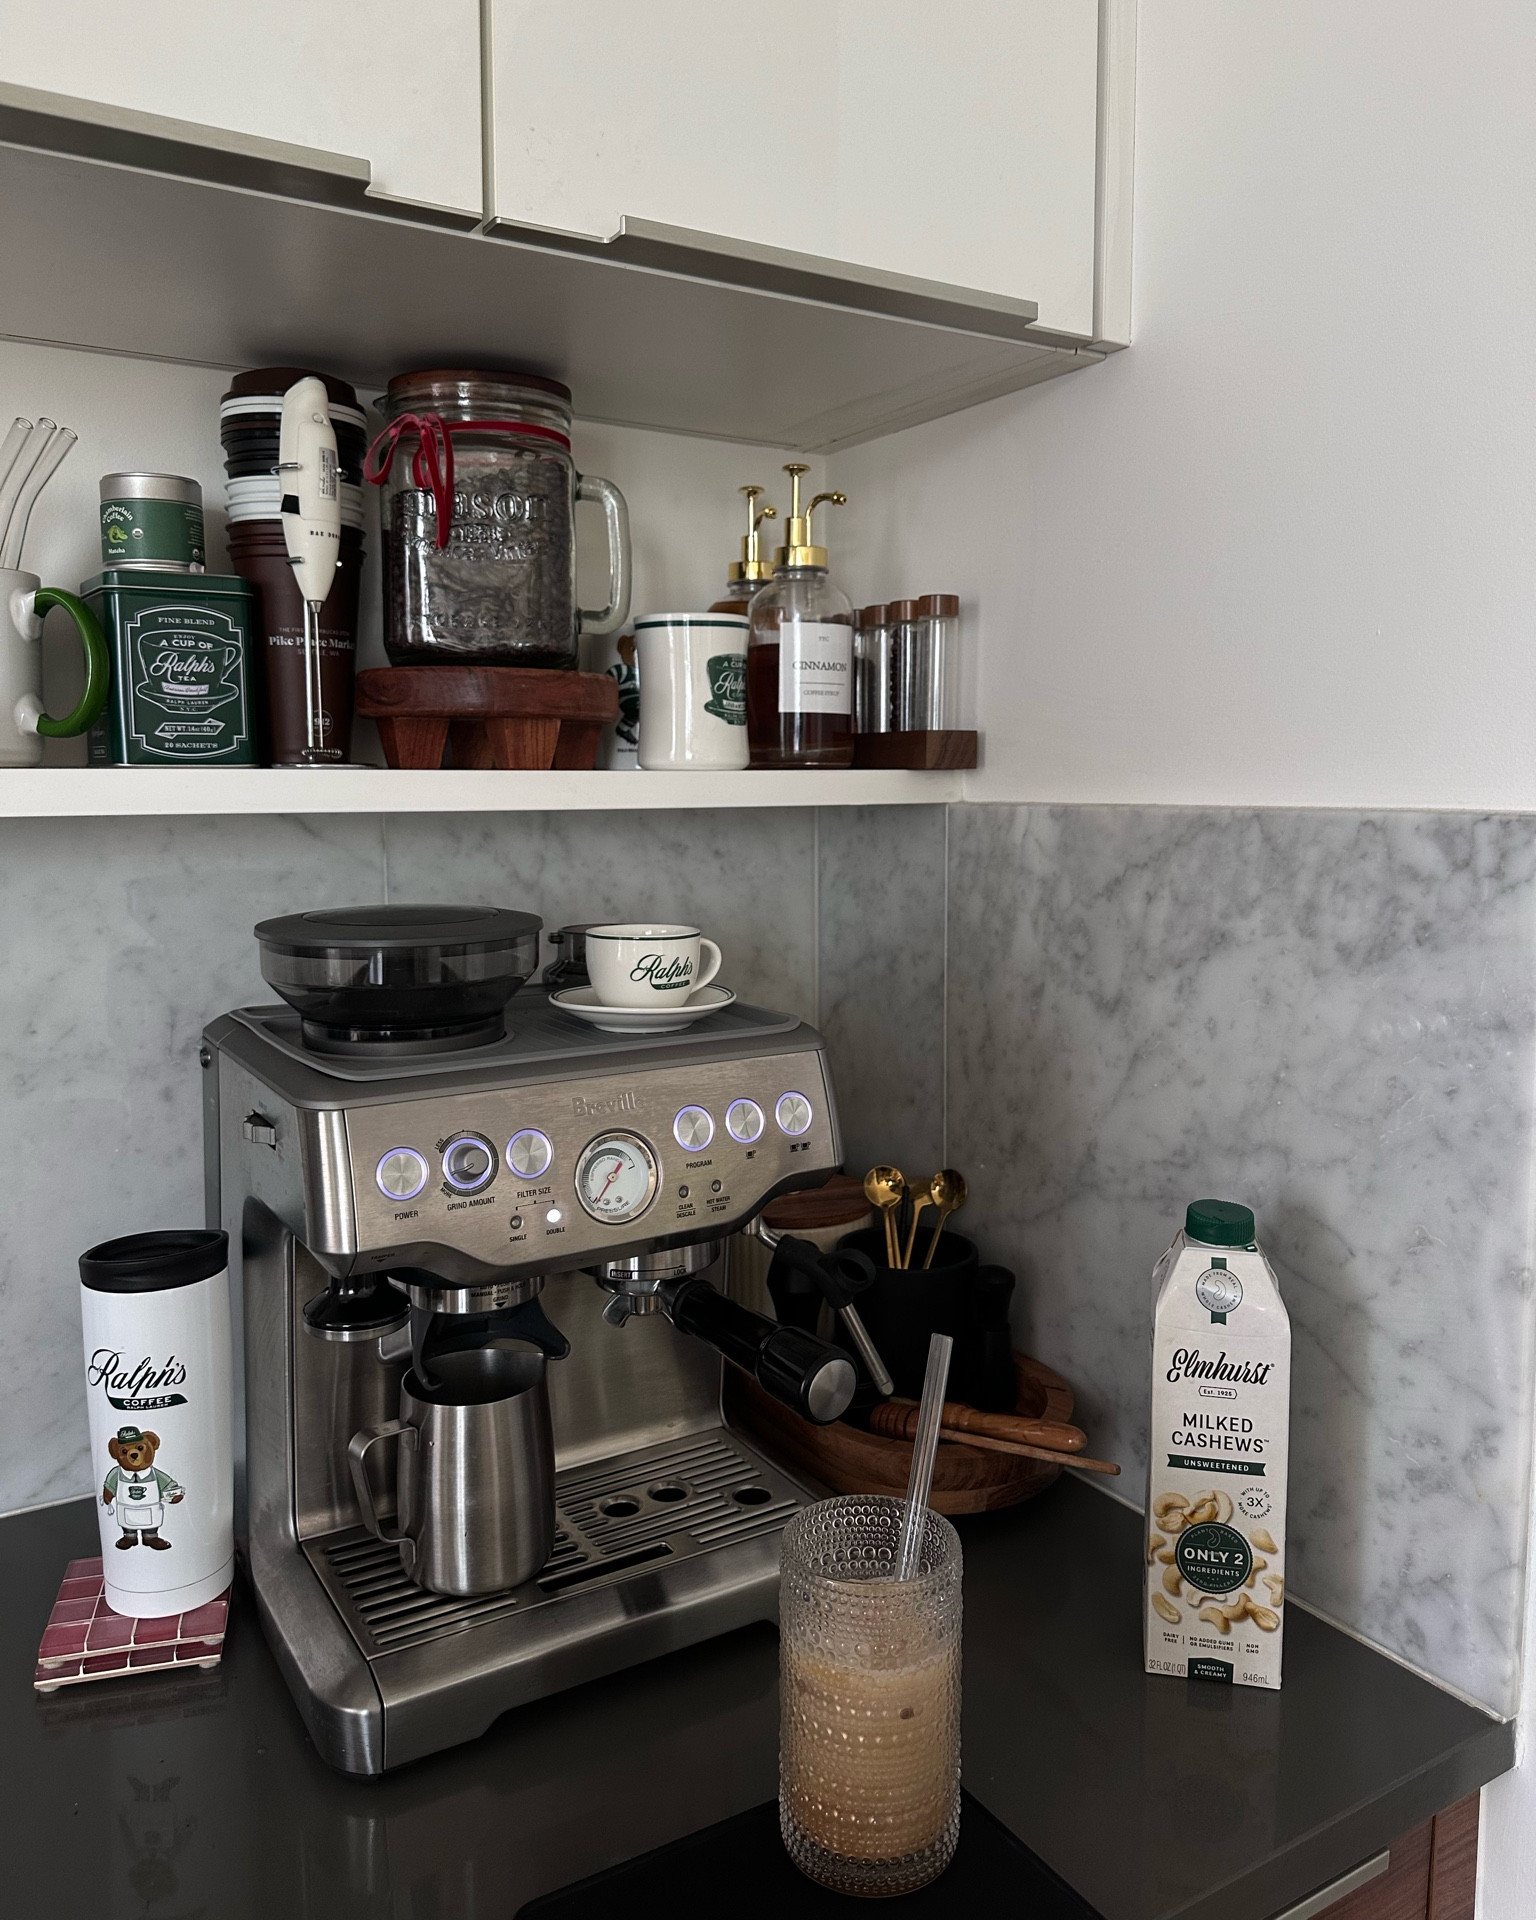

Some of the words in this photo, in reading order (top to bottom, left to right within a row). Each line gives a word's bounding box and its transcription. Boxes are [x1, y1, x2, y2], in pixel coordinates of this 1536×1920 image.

[107, 512, 124, 523] Coffee
[269, 635, 294, 646] Pike
[295, 637, 327, 648] Pace
[329, 638, 355, 650] Mark
[150, 651, 215, 683] Ralph's
[792, 660, 847, 672] CINNAMON
[630, 954, 693, 985] Ralph's
[660, 981, 686, 989] COFFEE
[434, 1137, 445, 1150] LESS
[685, 1159, 712, 1169] PROGRAM
[440, 1187, 454, 1198] MORE
[517, 1189, 537, 1199] FILTER
[538, 1186, 552, 1195] SIZE
[447, 1202, 467, 1211] GRIND
[468, 1197, 496, 1208] AMOUNT
[597, 1200, 630, 1213] PRESSURE
[678, 1202, 693, 1210] CLEAN
[394, 1210, 419, 1221] POWER
[676, 1210, 696, 1218] DESCALE
[546, 1227, 566, 1235] DOUBLE
[509, 1234, 527, 1242] SINGLE
[611, 1270, 632, 1278] INSERT
[673, 1268, 687, 1276] LOCK
[1201, 1273, 1212, 1286] MADE
[88, 1349, 187, 1397] Ralph's
[1217, 1389, 1233, 1397] 1925
[123, 1396, 172, 1406] COFFEE
[1183, 1413, 1253, 1433] MILKED
[1184, 1459, 1250, 1472] UNSWEETENED
[1240, 1487, 1254, 1496] WITH
[1246, 1496, 1263, 1508] 3X
[1238, 1502, 1249, 1516] MORE
[1184, 1547, 1229, 1563] ONLY
[1234, 1553, 1244, 1565] 2
[1187, 1565, 1240, 1577] INGREDIENTS
[1163, 1631, 1179, 1639] DAIRY
[1198, 1637, 1217, 1645] ADDED
[1199, 1642, 1234, 1651] EMULSIFIERS
[1148, 1659, 1156, 1669] 32
[1156, 1660, 1162, 1670] FL
[1163, 1661, 1171, 1671] OZ
[1197, 1664, 1225, 1672] SMOOTH
[1200, 1670, 1227, 1678] CREAMY
[1242, 1672, 1270, 1685] 946mL
